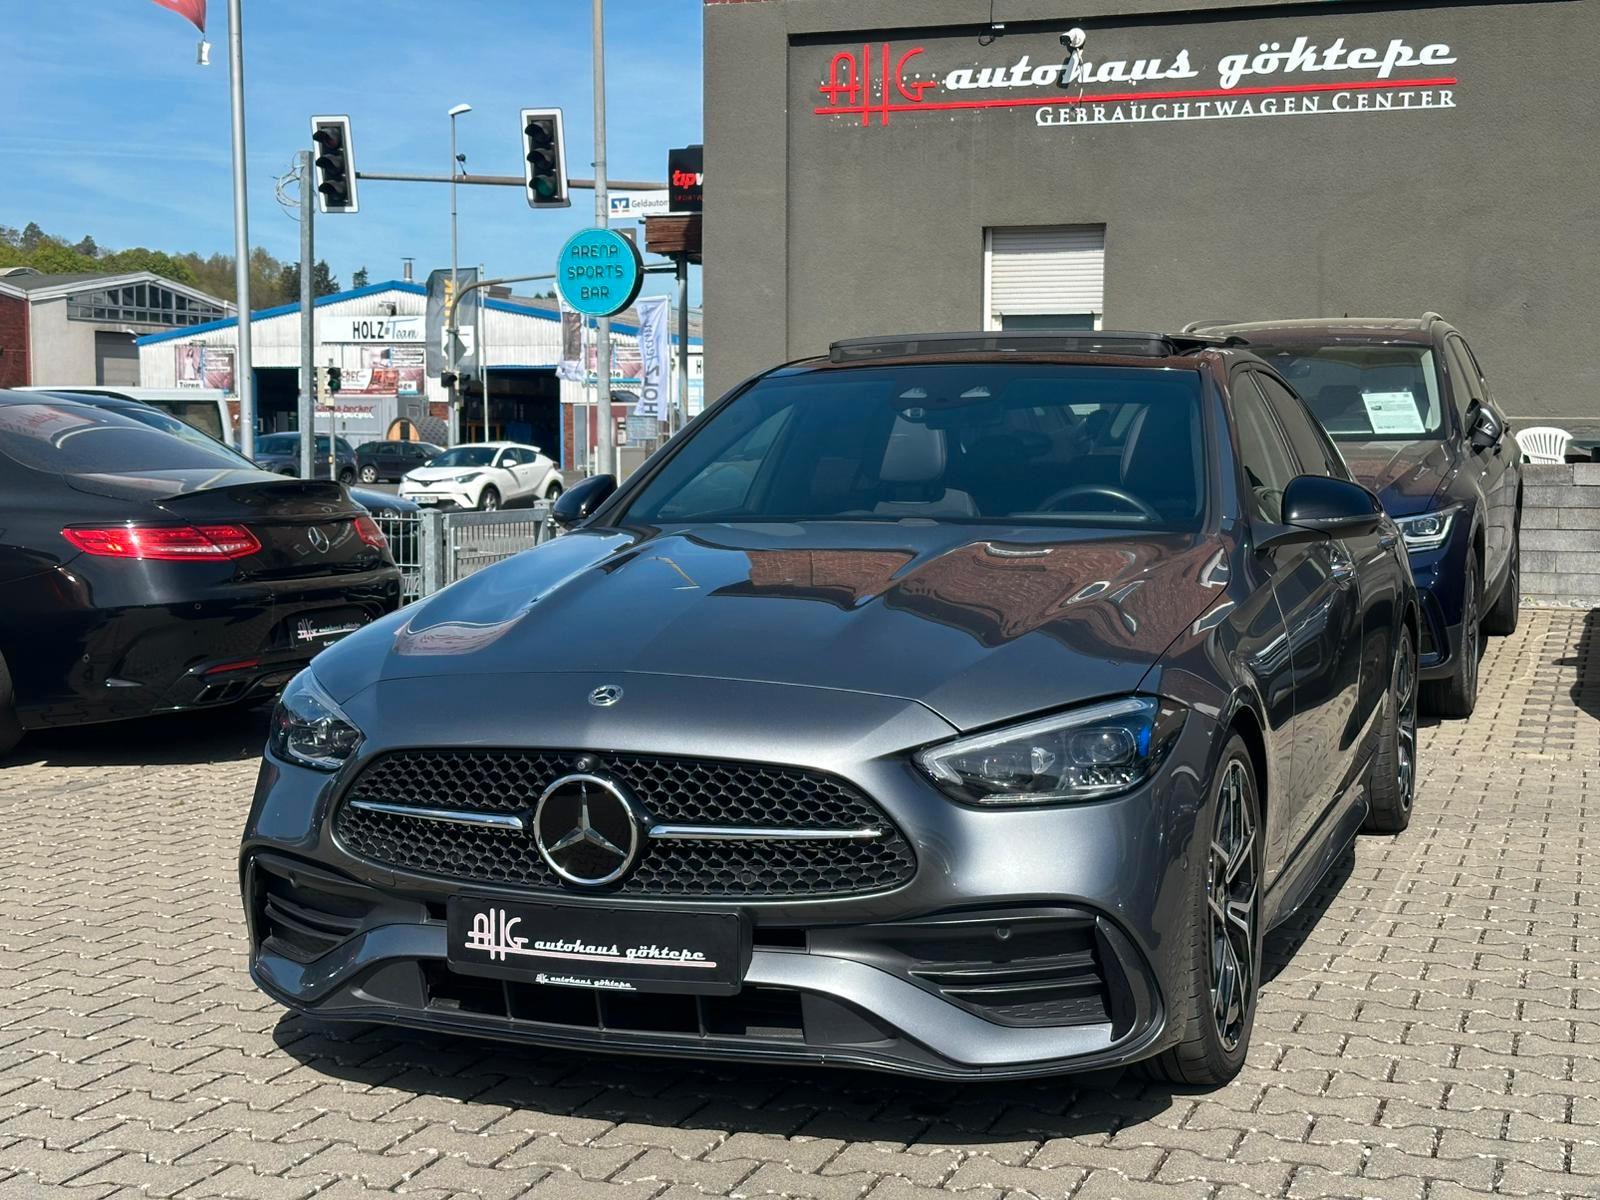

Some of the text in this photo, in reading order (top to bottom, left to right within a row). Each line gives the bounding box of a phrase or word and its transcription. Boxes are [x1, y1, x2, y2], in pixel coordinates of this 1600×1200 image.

[946, 49, 1199, 90] autohaus
[1216, 36, 1458, 89] göktepe
[1332, 90, 1457, 112] CENTER
[571, 244, 619, 257] ARENA
[568, 264, 624, 280] SPORTS
[580, 285, 610, 299] BAR
[352, 320, 385, 340] HOLZ
[533, 938, 620, 956] autohaus
[626, 944, 706, 961] göktepe
